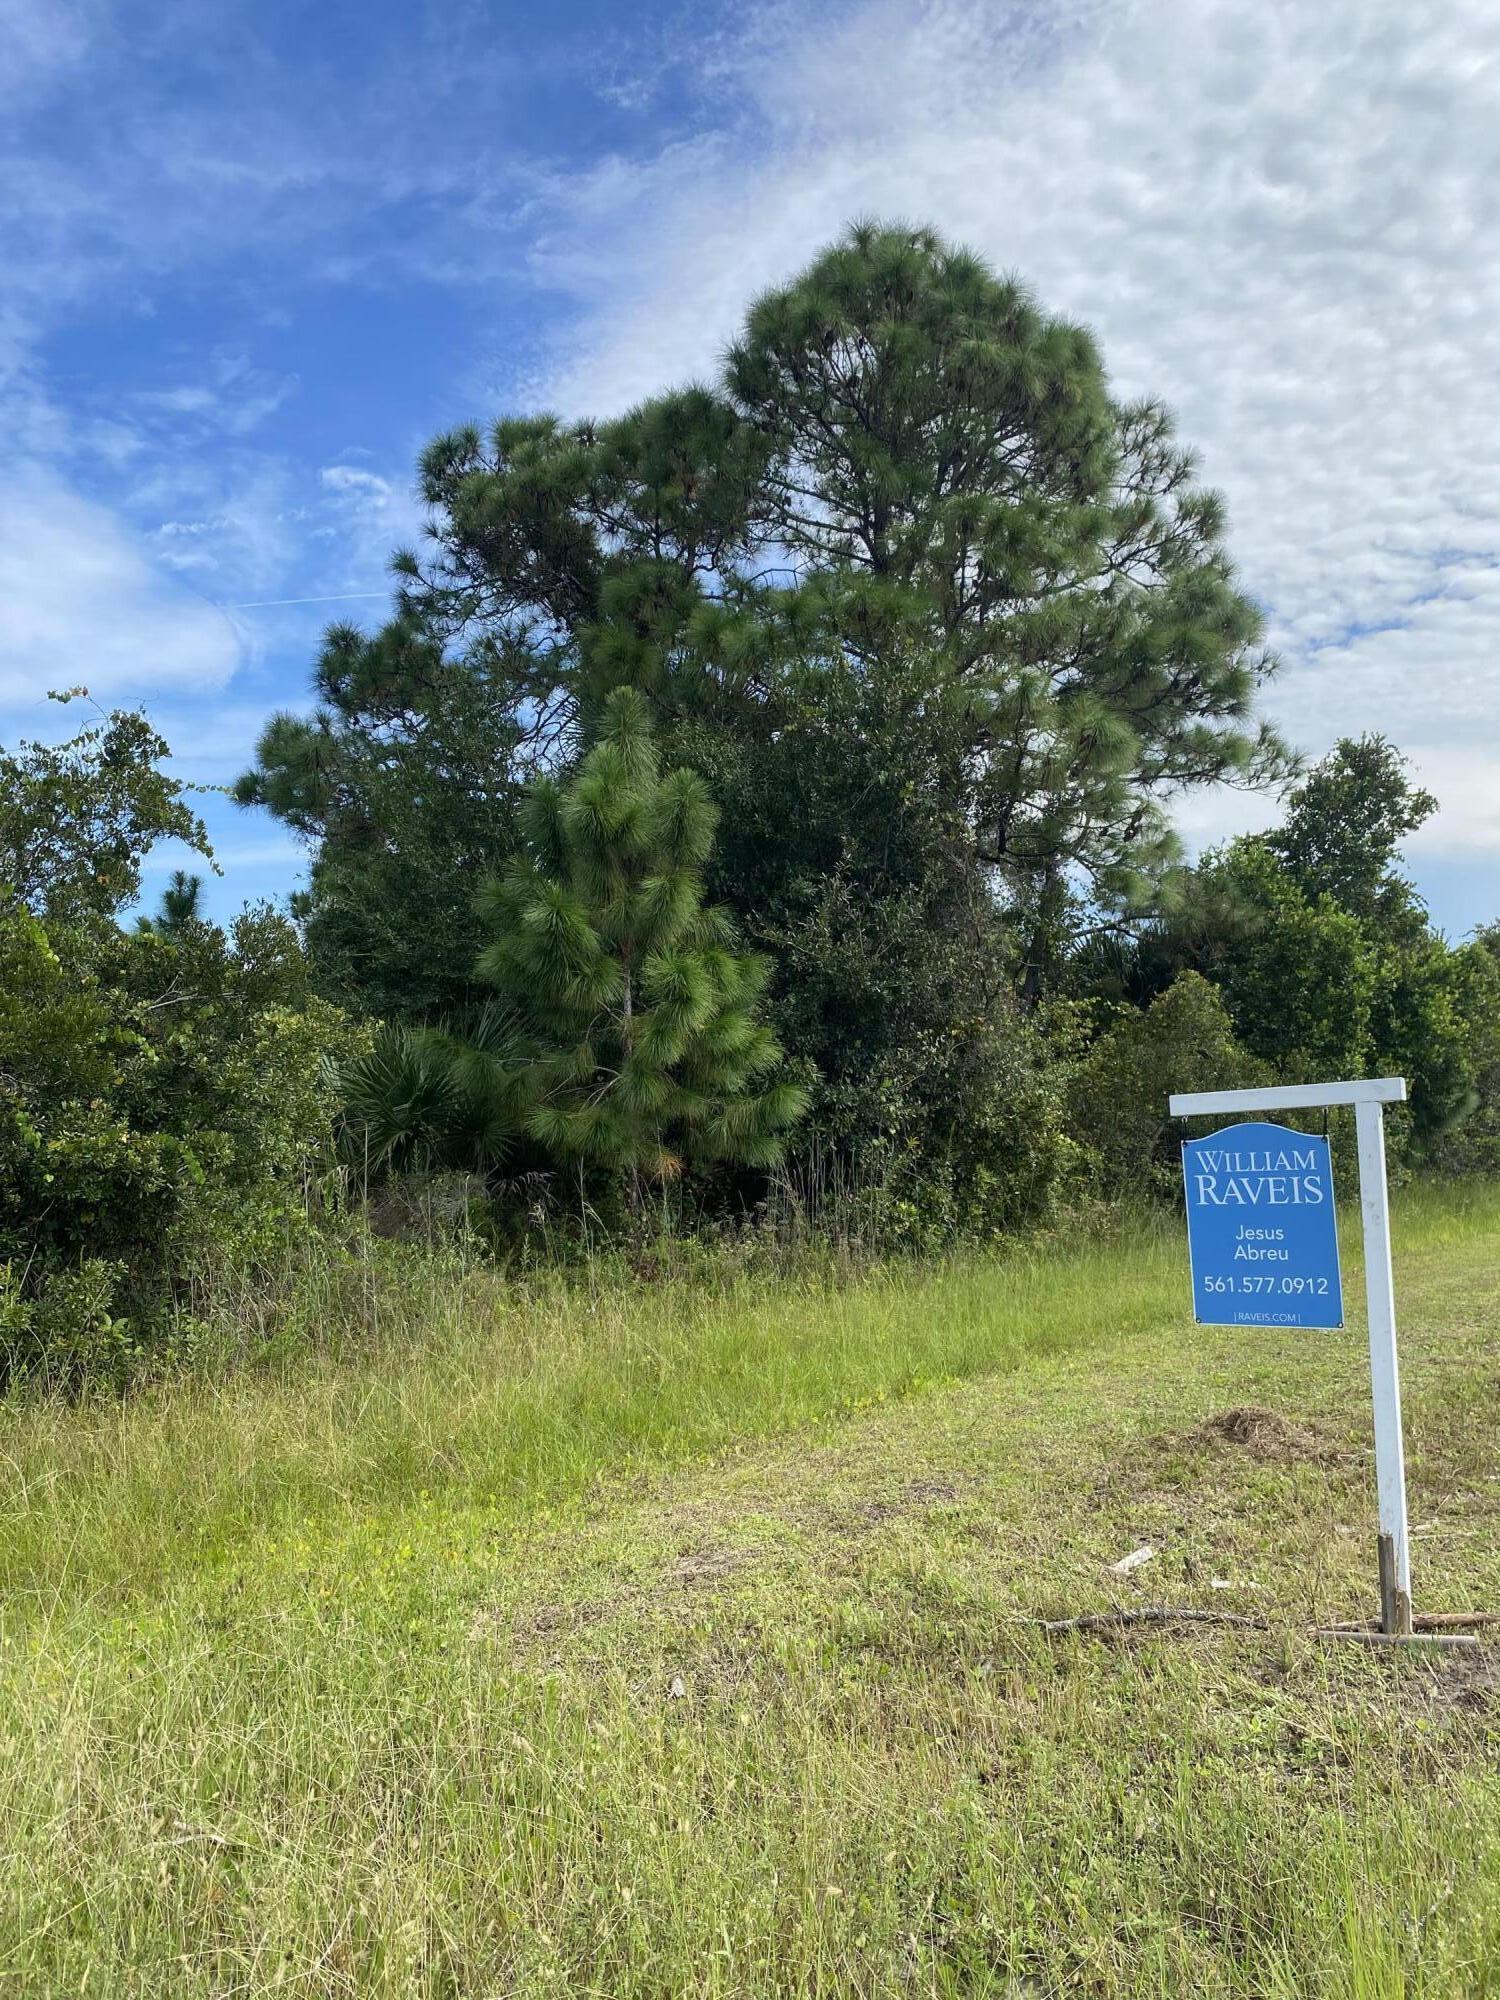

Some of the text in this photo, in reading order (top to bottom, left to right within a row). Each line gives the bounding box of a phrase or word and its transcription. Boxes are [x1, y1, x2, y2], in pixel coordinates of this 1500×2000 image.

[1196, 1150, 1317, 1173] WILLIAM
[1194, 1175, 1324, 1205] RAVEIS
[1235, 1225, 1285, 1240] Jesus
[1234, 1244, 1289, 1261] Abreu
[1204, 1276, 1329, 1295] 561.577.0912
